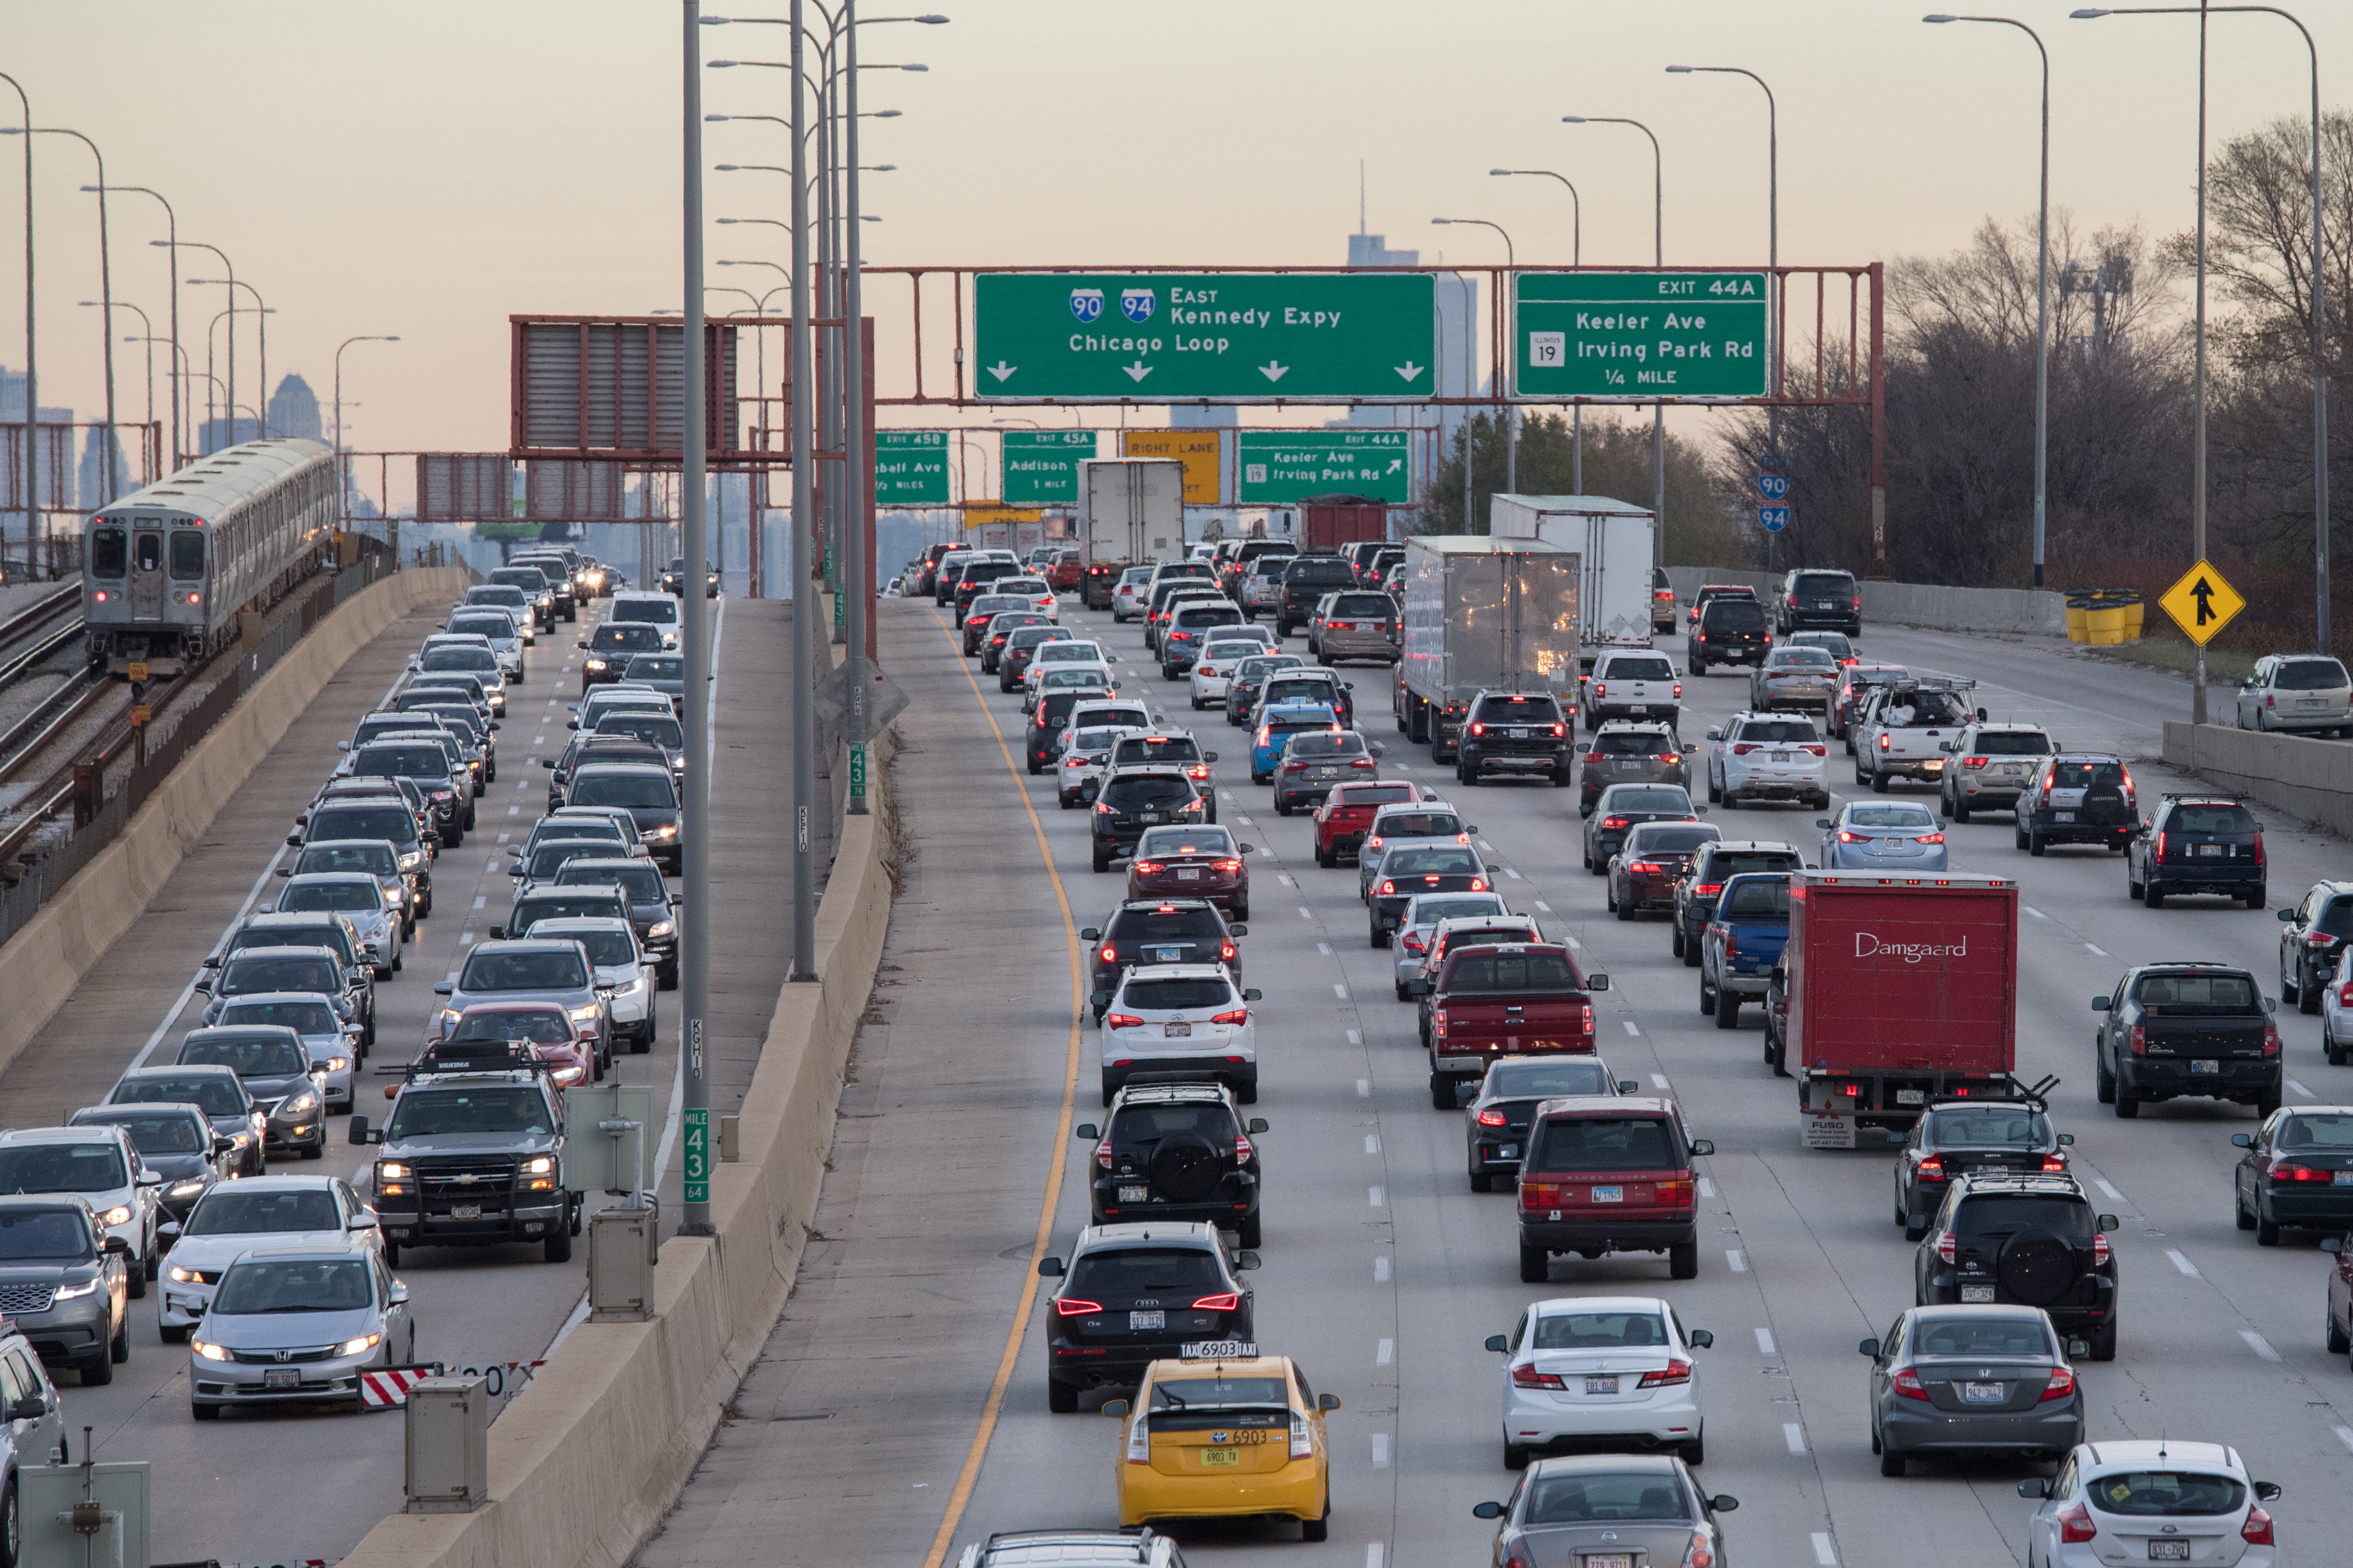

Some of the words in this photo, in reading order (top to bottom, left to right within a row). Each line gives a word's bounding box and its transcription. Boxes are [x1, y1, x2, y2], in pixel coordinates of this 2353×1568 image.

[1659, 280, 1695, 294] EXIT
[1709, 280, 1755, 295] 44A
[1171, 287, 1218, 304] EAST
[1073, 297, 1099, 316] 90
[1125, 297, 1151, 316] 94
[1171, 307, 1270, 328] Kennedy
[1284, 307, 1341, 328] Expy
[1577, 312, 1649, 329] Keeler
[1664, 312, 1706, 329] Ave
[1069, 334, 1162, 356] Chicago
[1176, 333, 1229, 355] Loop
[1578, 341, 1647, 363] Irving
[1659, 340, 1711, 358] Park
[1725, 341, 1753, 357] Rd
[1539, 346, 1556, 361] 19
[1637, 370, 1676, 384] MILE
[913, 434, 941, 445] 45B
[1036, 434, 1055, 442] EXIT
[1062, 433, 1088, 444] 45A
[1346, 434, 1365, 443] EXIT
[1372, 434, 1400, 444] 44A
[1131, 443, 1170, 454] RIGHT
[1179, 443, 1213, 453] LANE
[1274, 452, 1318, 463] Keeler
[1327, 451, 1354, 463] Ave
[876, 463, 906, 474] ball
[914, 463, 941, 473] Ave
[1010, 461, 1067, 471] Addison
[1274, 469, 1317, 483] Irving
[1323, 469, 1355, 481] Park
[1361, 469, 1379, 480] Rd
[896, 481, 924, 489] MILES
[1034, 480, 1039, 489] 1
[1762, 478, 1785, 493] 90
[1762, 510, 1785, 526] 94
[851, 742, 865, 752] MILE
[852, 753, 863, 783] 43
[1855, 932, 1967, 963] Damgaard
[685, 1112, 707, 1125] MILE
[687, 1128, 703, 1178] 43
[687, 1186, 702, 1198] 64
[1132, 1316, 1143, 1325] S17
[1148, 1316, 1162, 1325] 3179
[1181, 1344, 1199, 1357] TAXI
[1201, 1341, 1236, 1356] 6903
[1238, 1343, 1256, 1356] TAXI
[1586, 1381, 1598, 1391] E81
[1602, 1381, 1619, 1391] 0408
[1968, 1388, 1981, 1398] 942
[1232, 1430, 1268, 1444] 6903
[1206, 1452, 1225, 1462] 6903
[1228, 1452, 1237, 1461] TX
